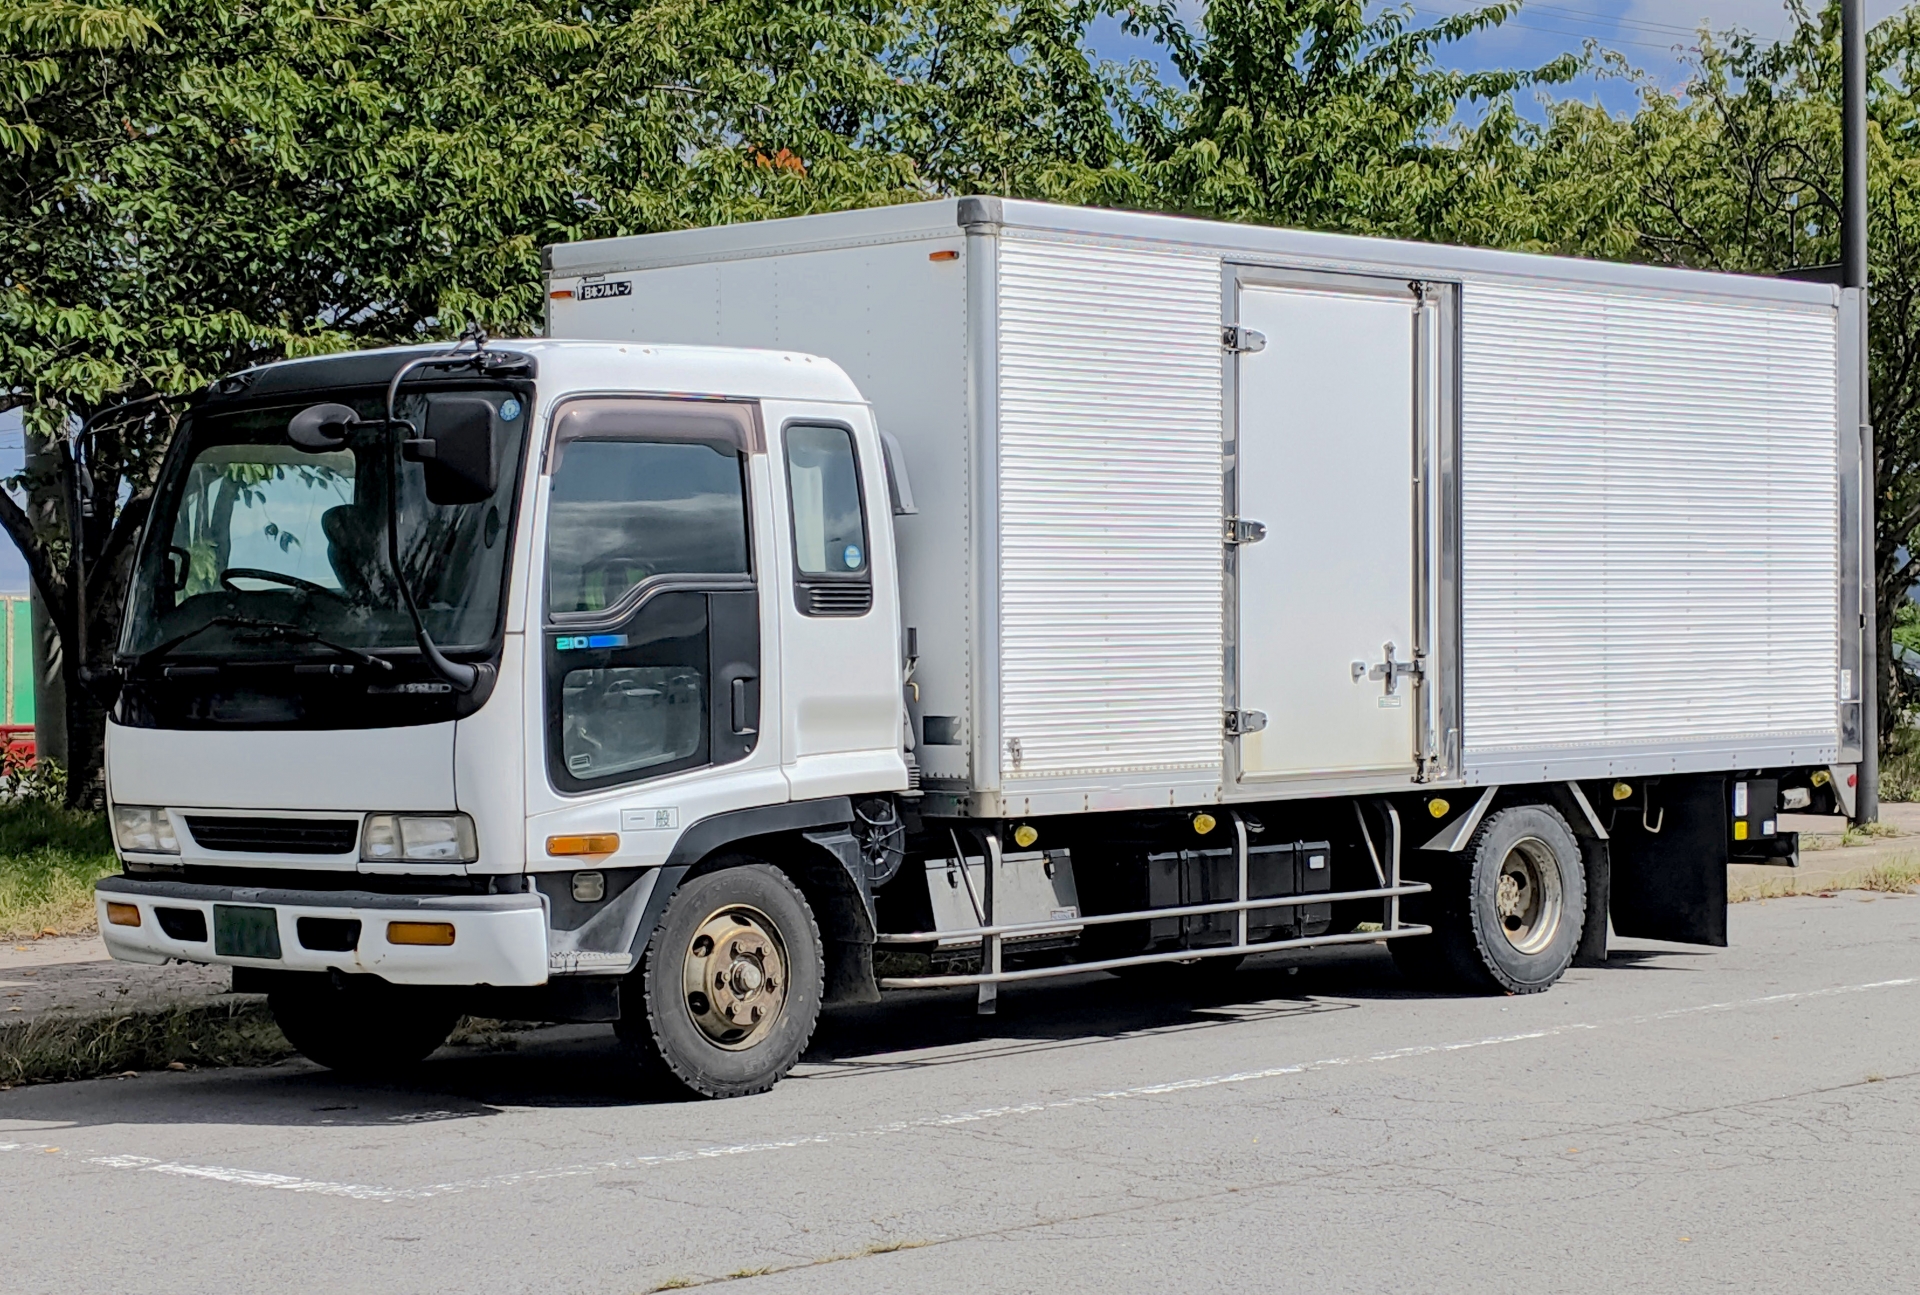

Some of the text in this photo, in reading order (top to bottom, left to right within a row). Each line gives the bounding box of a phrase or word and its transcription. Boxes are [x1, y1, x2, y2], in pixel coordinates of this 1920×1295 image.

[584, 282, 632, 299] 日本フルハーフ
[556, 635, 589, 650] 210
